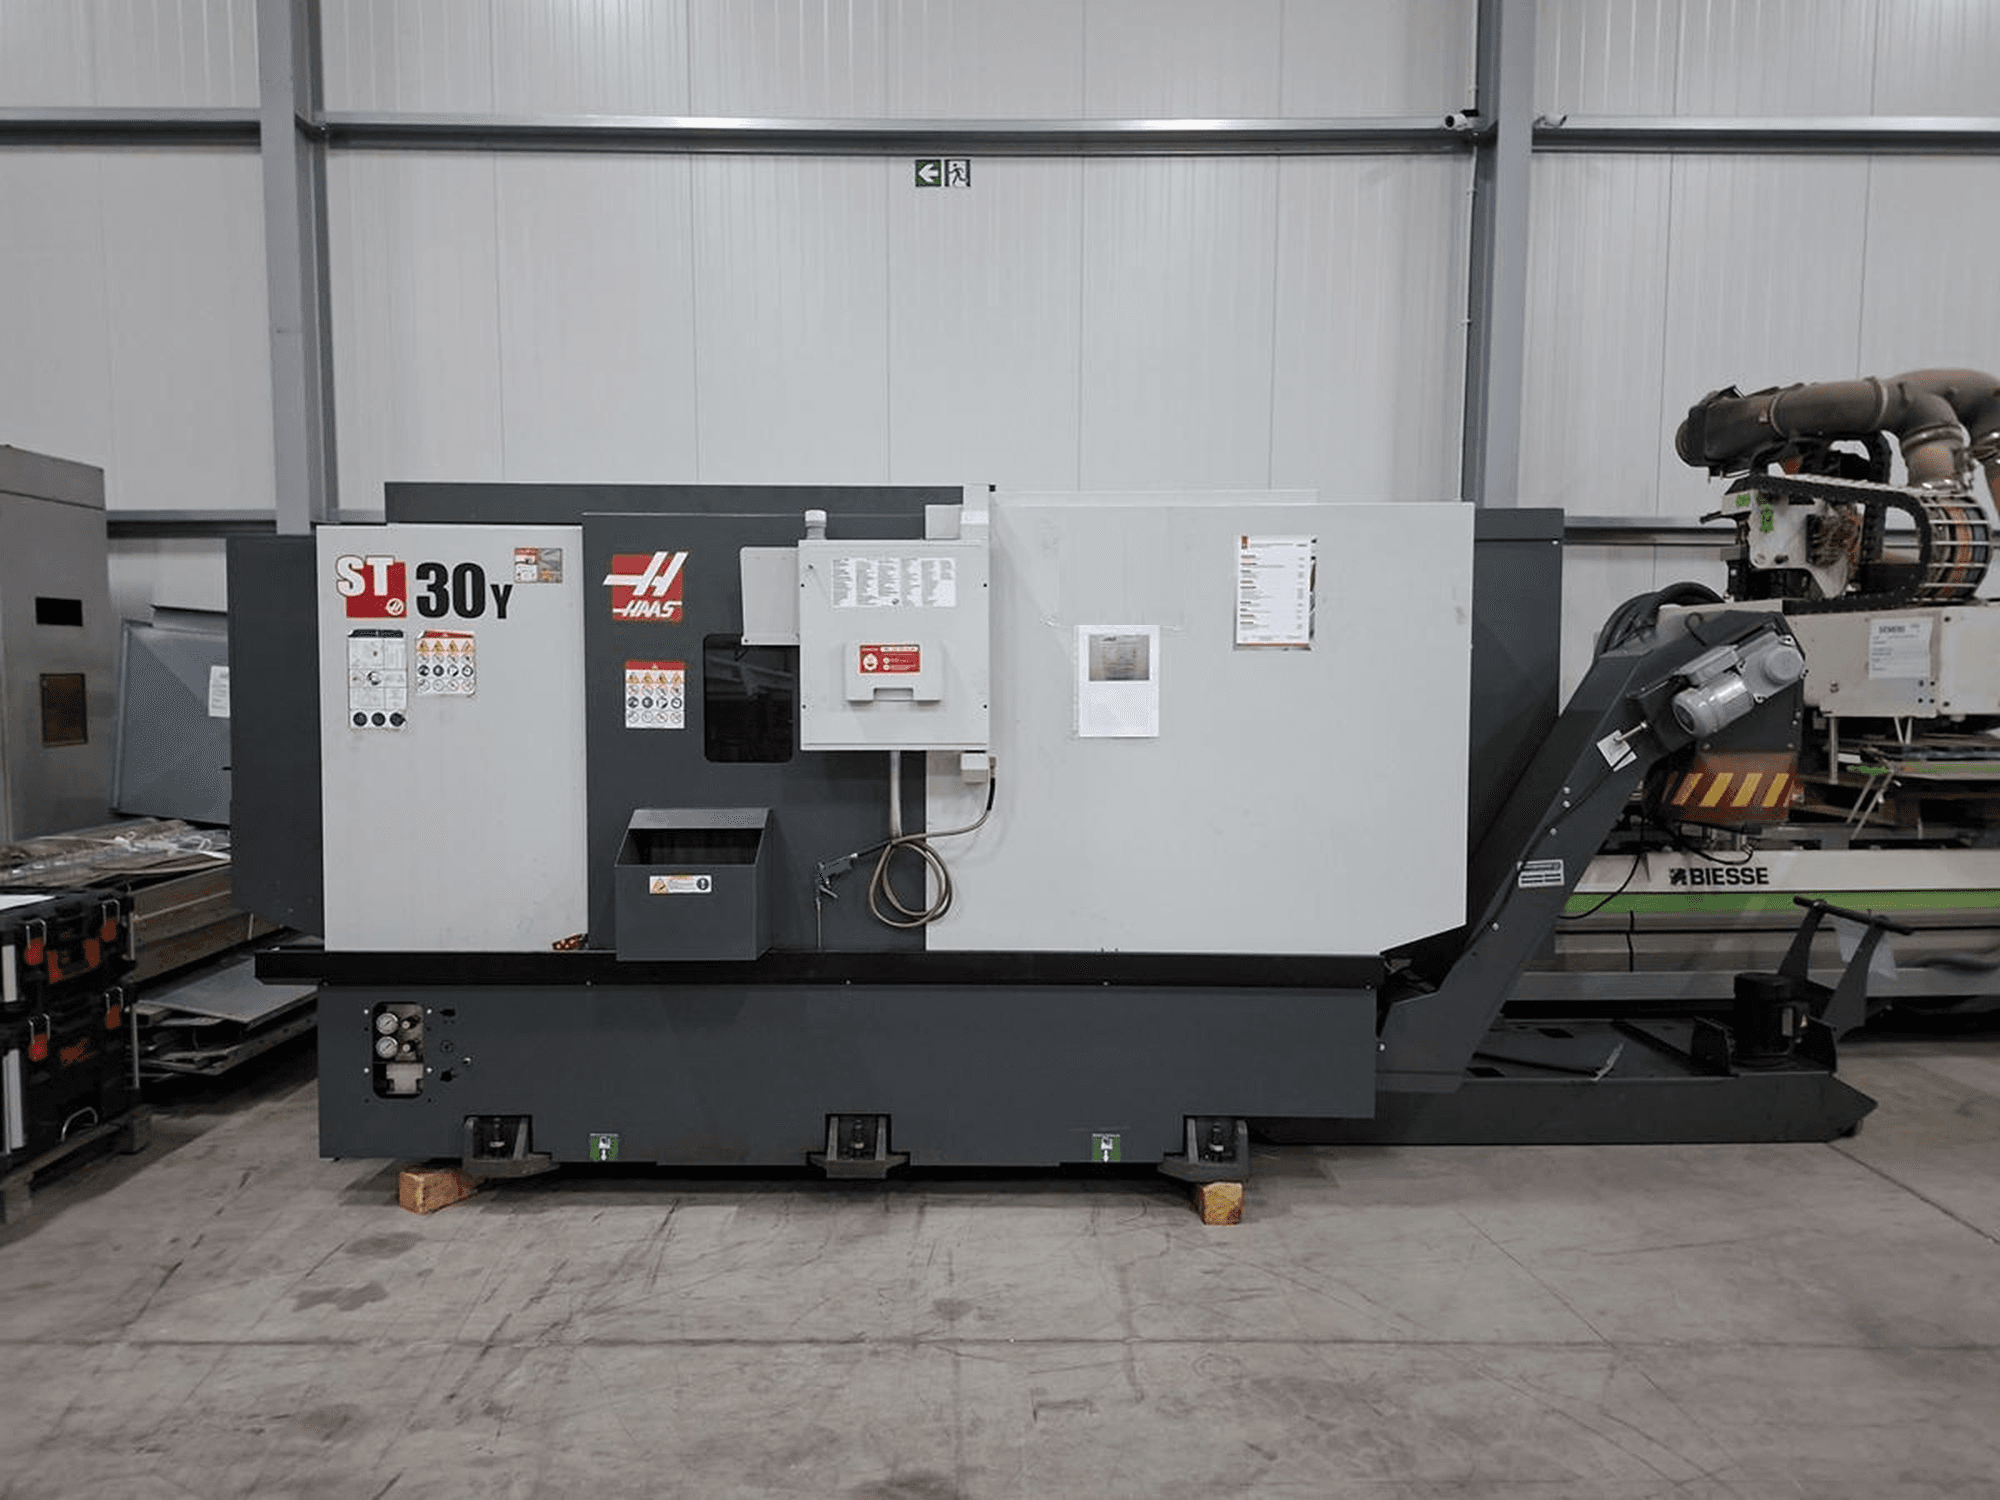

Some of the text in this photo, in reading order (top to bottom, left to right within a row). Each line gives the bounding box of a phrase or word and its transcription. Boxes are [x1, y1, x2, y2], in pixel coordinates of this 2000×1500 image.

[335, 554, 396, 598] ST
[613, 600, 682, 617] HAAS
[1690, 867, 1769, 886] BIESSE
